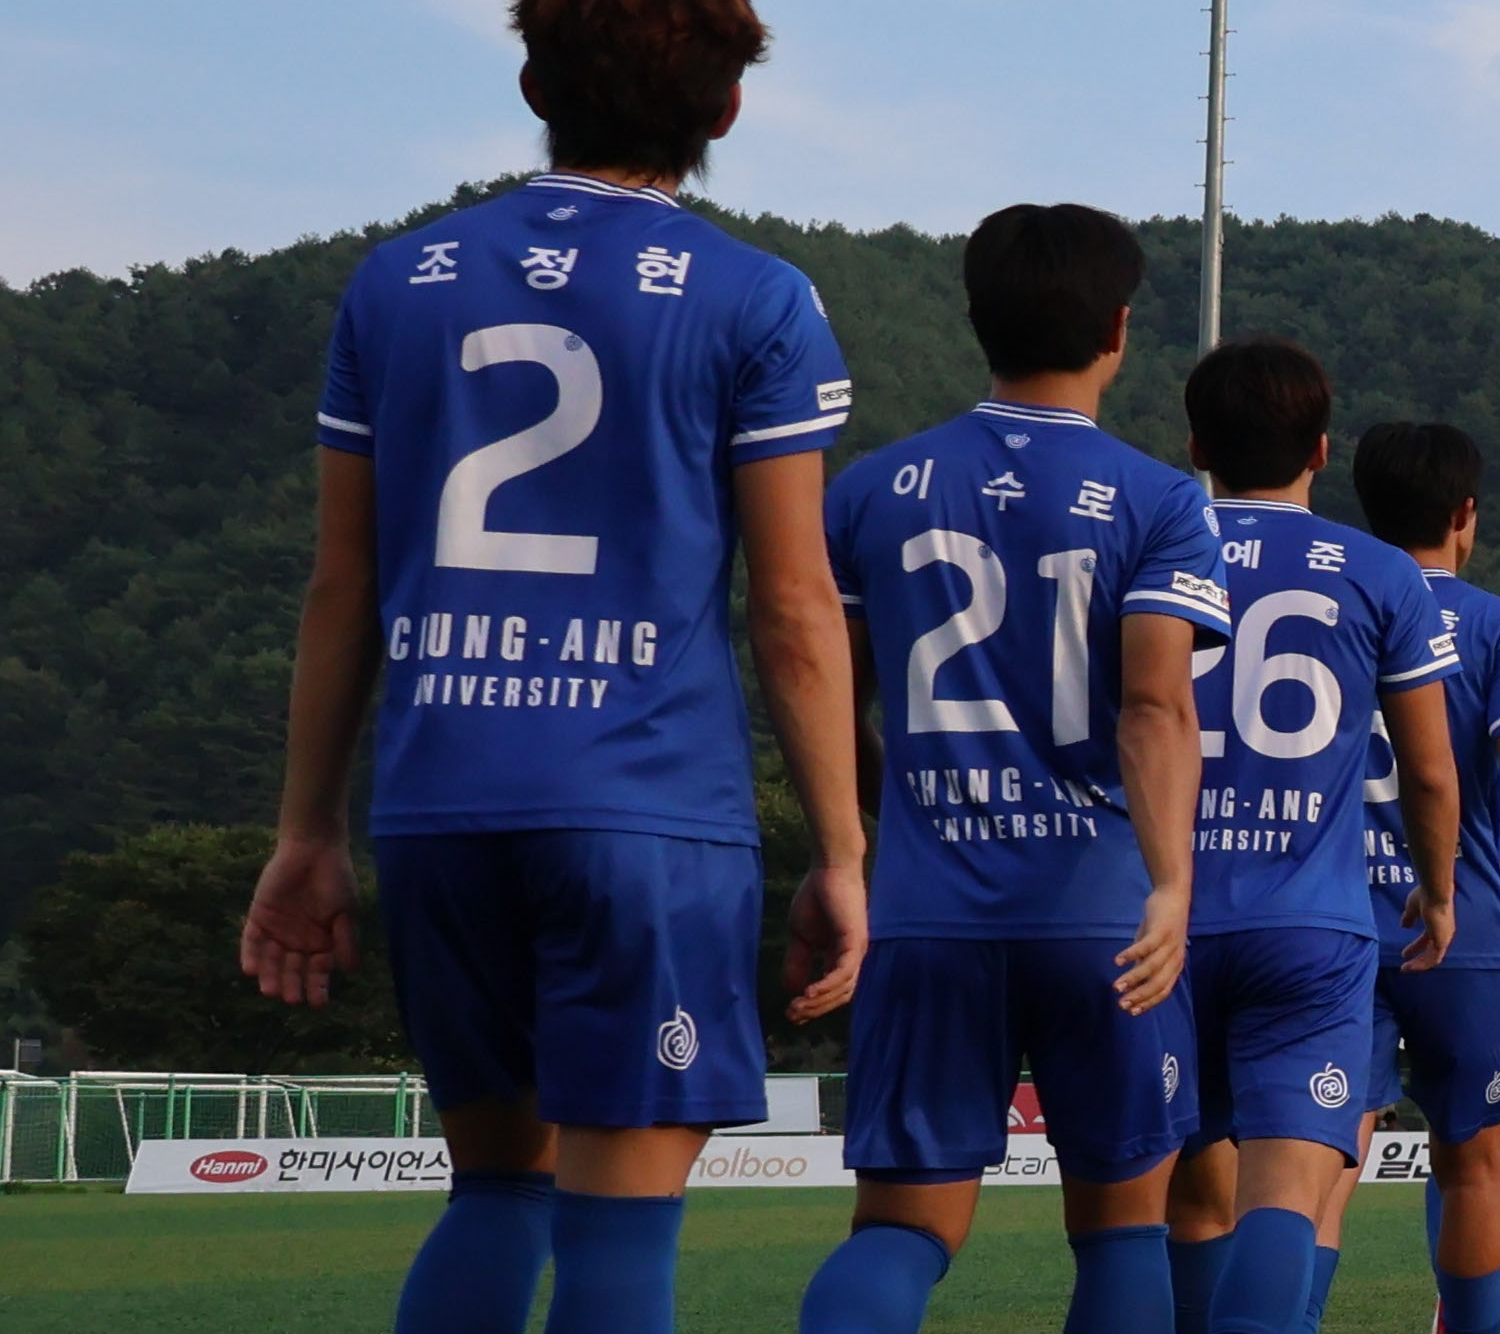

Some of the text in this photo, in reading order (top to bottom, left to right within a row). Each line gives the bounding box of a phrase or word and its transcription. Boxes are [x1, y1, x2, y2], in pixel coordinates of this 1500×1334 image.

[435, 324, 602, 574] 2
[1222, 539, 1347, 573] 예준
[389, 613, 657, 666] CUNG-ANG
[902, 528, 1096, 746] 21
[413, 674, 608, 708] NIVERSITY
[1201, 786, 1323, 823] NG-ANG
[933, 813, 1098, 842] NIVERSITY
[1192, 829, 1292, 853] IVERSITY
[195, 1157, 264, 1176] Hanmi
[278, 1148, 450, 1181] 한미사이언스
